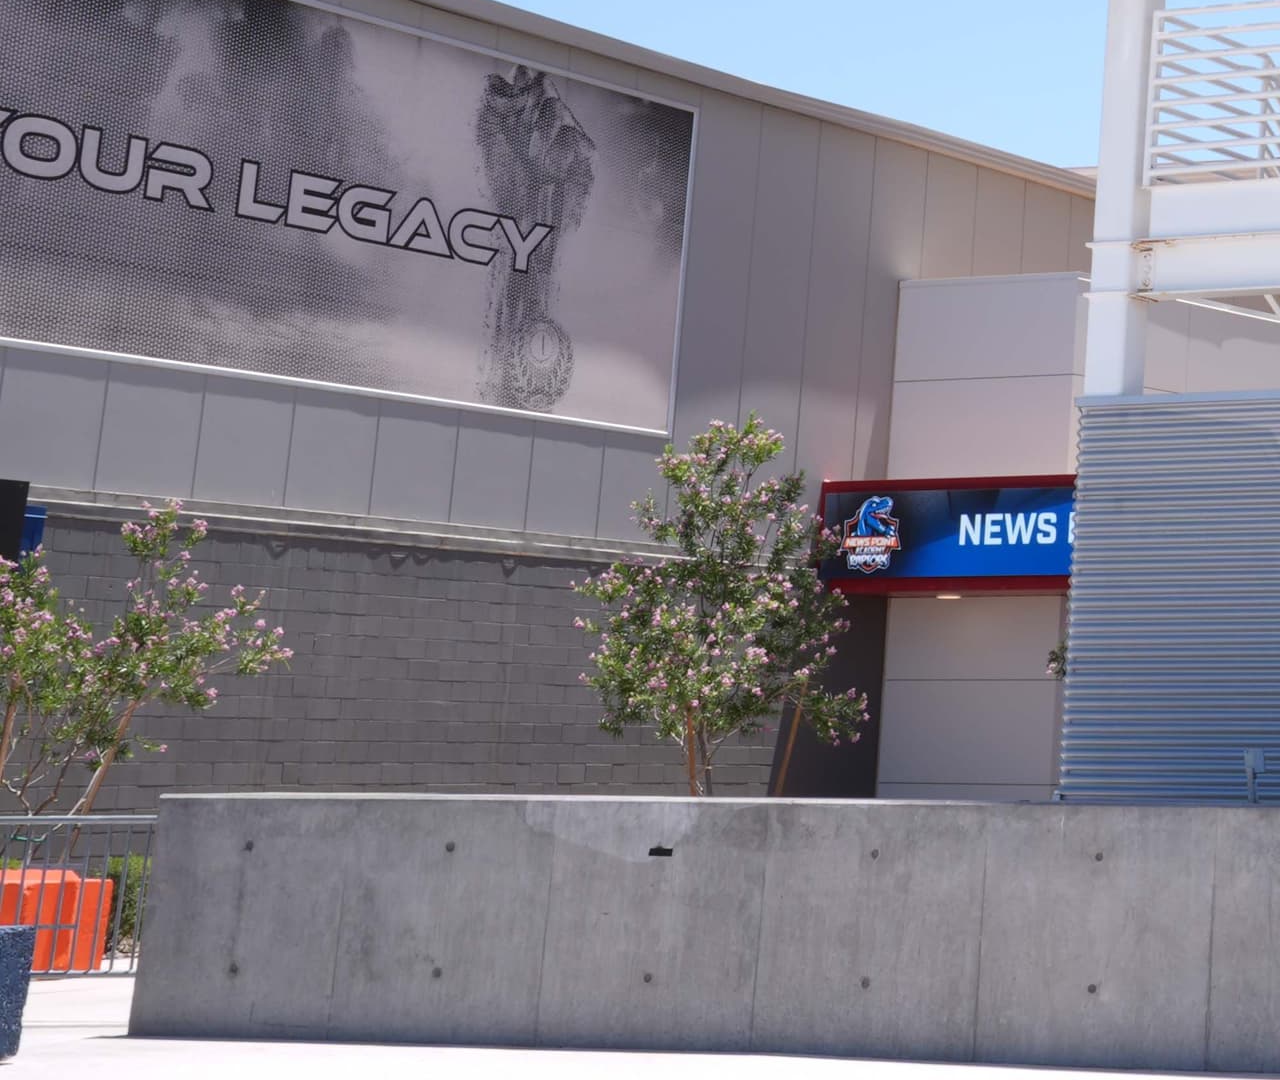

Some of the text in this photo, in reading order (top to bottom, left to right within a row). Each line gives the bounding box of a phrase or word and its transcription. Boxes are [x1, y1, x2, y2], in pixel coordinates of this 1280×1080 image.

[0, 106, 553, 274] OUR LEGACY
[958, 511, 1057, 546] NEWS
